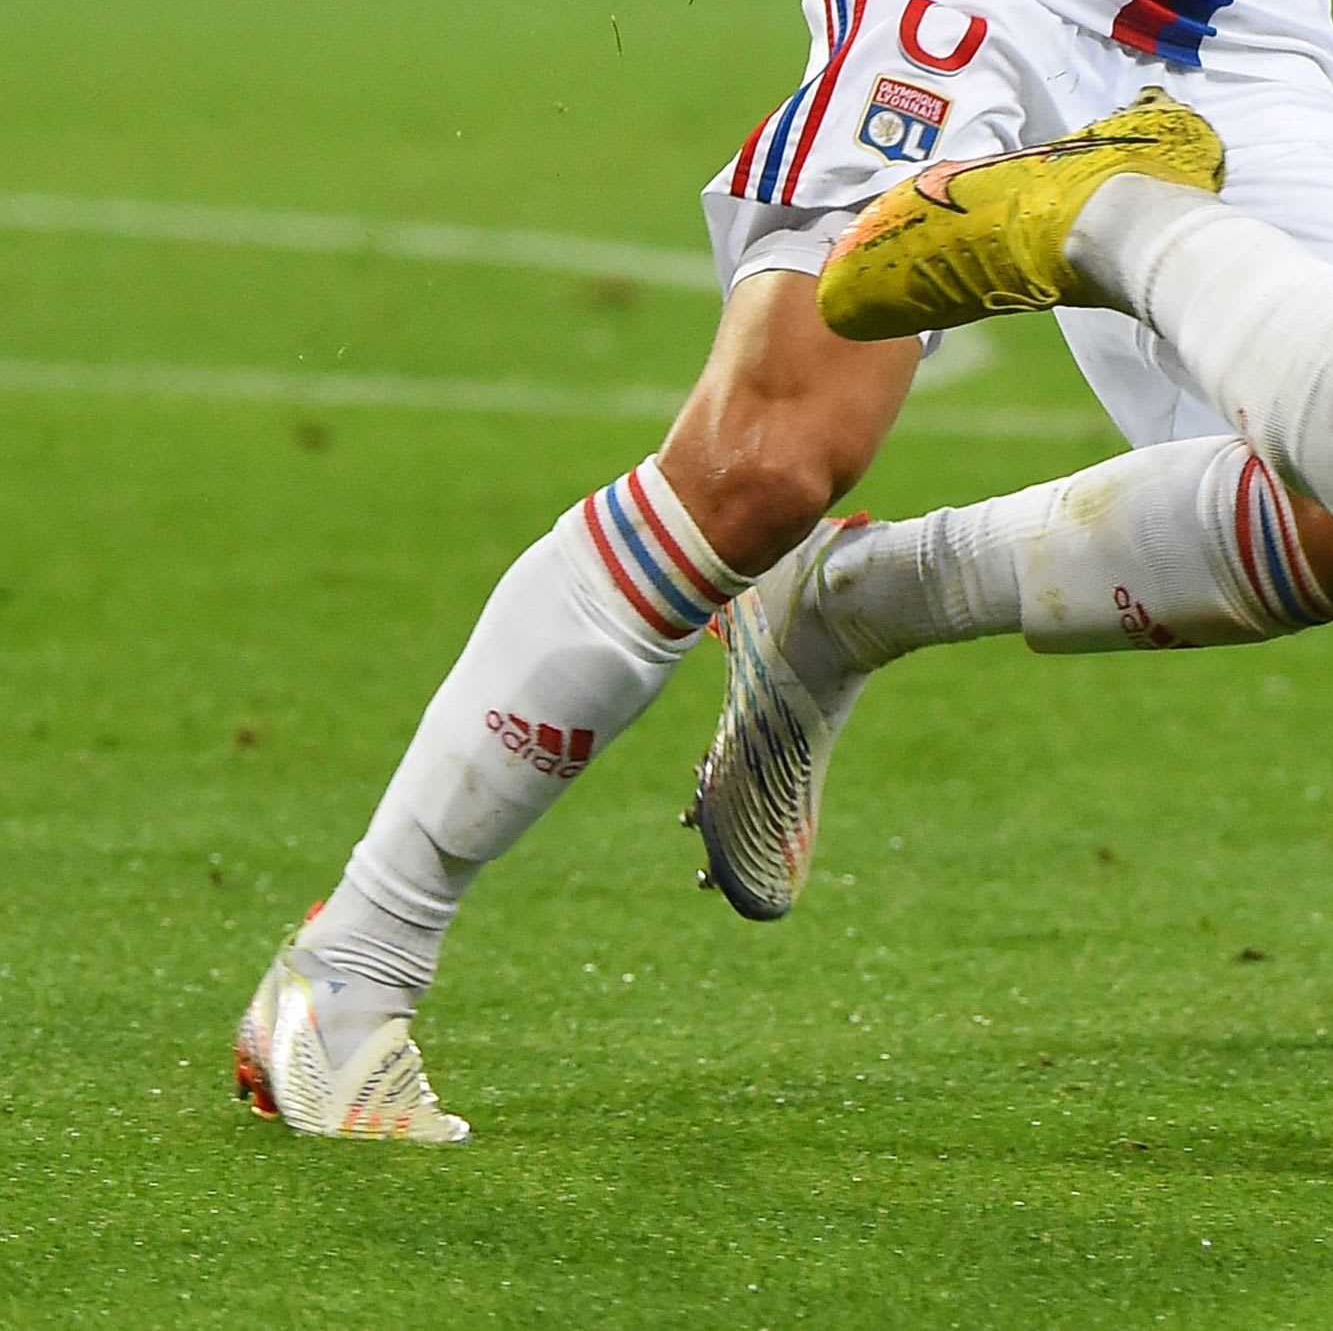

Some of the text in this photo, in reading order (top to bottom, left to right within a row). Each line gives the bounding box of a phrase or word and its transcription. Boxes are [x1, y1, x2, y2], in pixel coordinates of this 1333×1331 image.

[875, 89, 940, 121] LYONNAIS
[879, 80, 944, 110] OLYMPIQUE
[486, 709, 586, 779] adida
